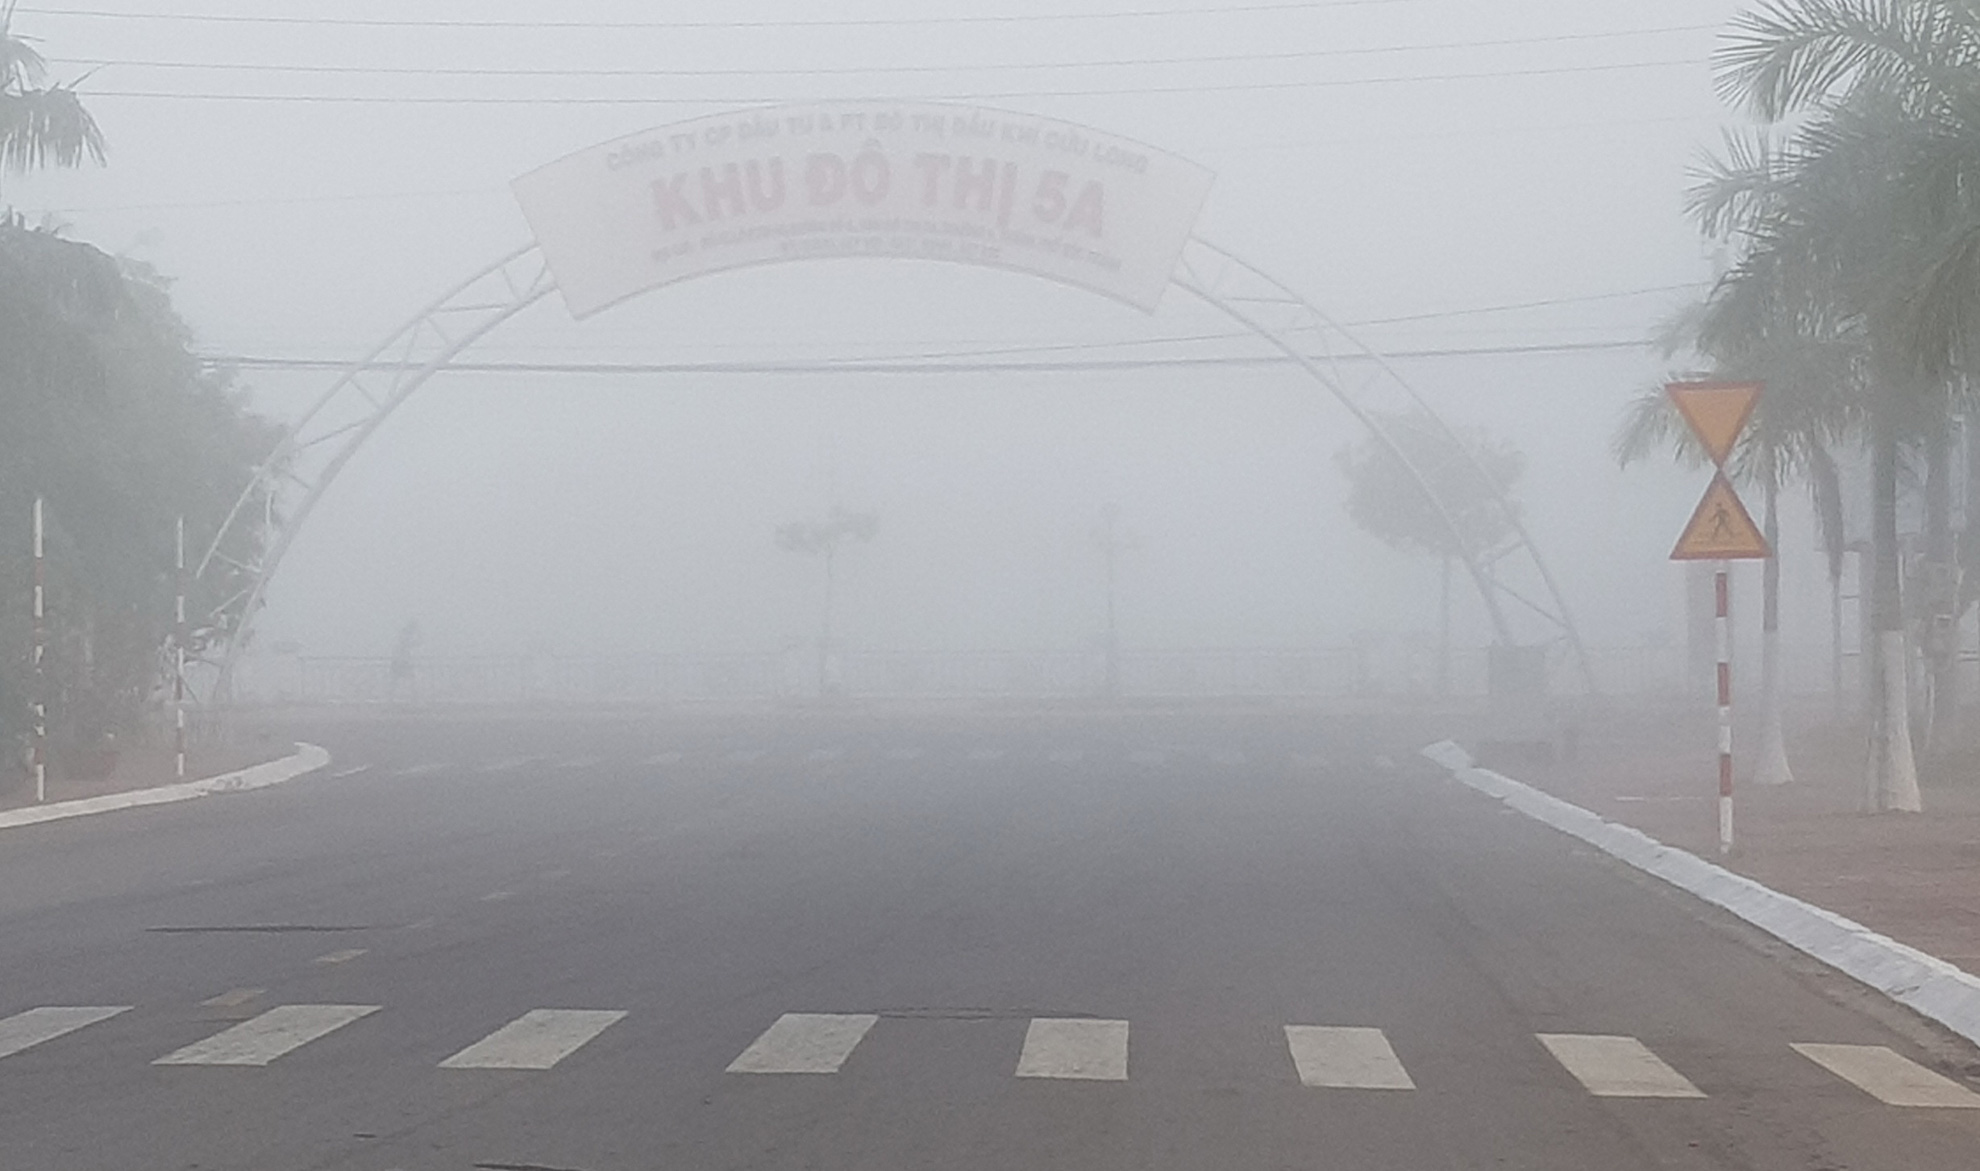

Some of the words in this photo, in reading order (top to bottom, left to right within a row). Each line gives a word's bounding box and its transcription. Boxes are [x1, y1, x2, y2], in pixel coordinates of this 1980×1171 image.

[669, 130, 697, 152] TY
[704, 124, 732, 146] CP
[841, 111, 866, 132] PT
[1092, 142, 1149, 176] LONG
[650, 154, 786, 231] KHU
[802, 137, 891, 206] ĐÔ
[914, 151, 1018, 230] THỊ
[1032, 169, 1105, 239] 5A
